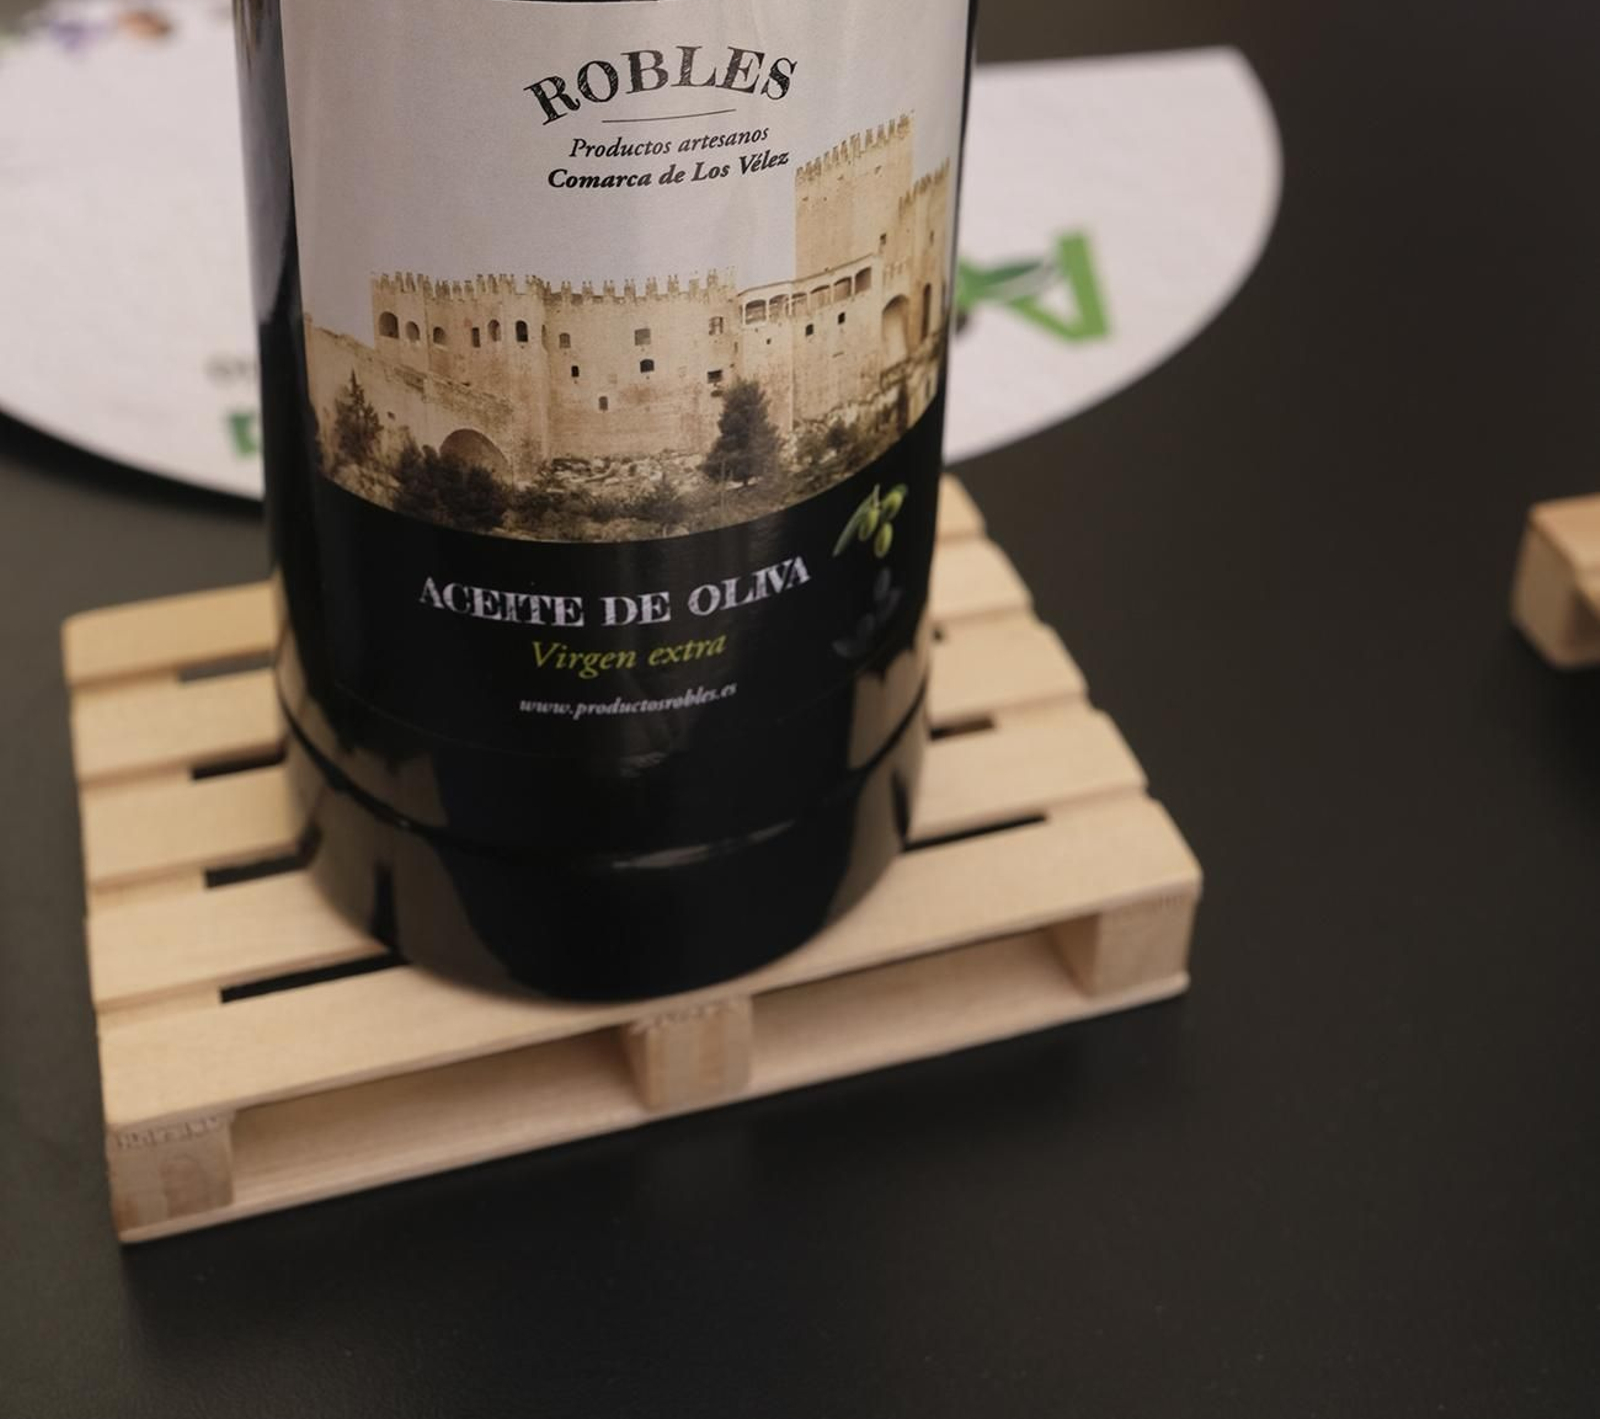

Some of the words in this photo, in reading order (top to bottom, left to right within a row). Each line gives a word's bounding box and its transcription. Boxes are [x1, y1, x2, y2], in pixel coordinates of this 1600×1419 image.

[523, 45, 798, 126] ROBLES
[569, 137, 671, 158] Productos
[677, 127, 770, 153] artesanos
[547, 168, 652, 190] Comarca
[658, 164, 687, 185] de
[690, 161, 730, 182] Los
[738, 150, 790, 175] Vélez
[418, 577, 585, 627] ACEITE
[600, 591, 672, 626] DE
[687, 556, 811, 617] OLIVA
[531, 640, 637, 679] Virgen
[648, 634, 727, 668] extra
[519, 683, 737, 720] www.productosrobles.es
